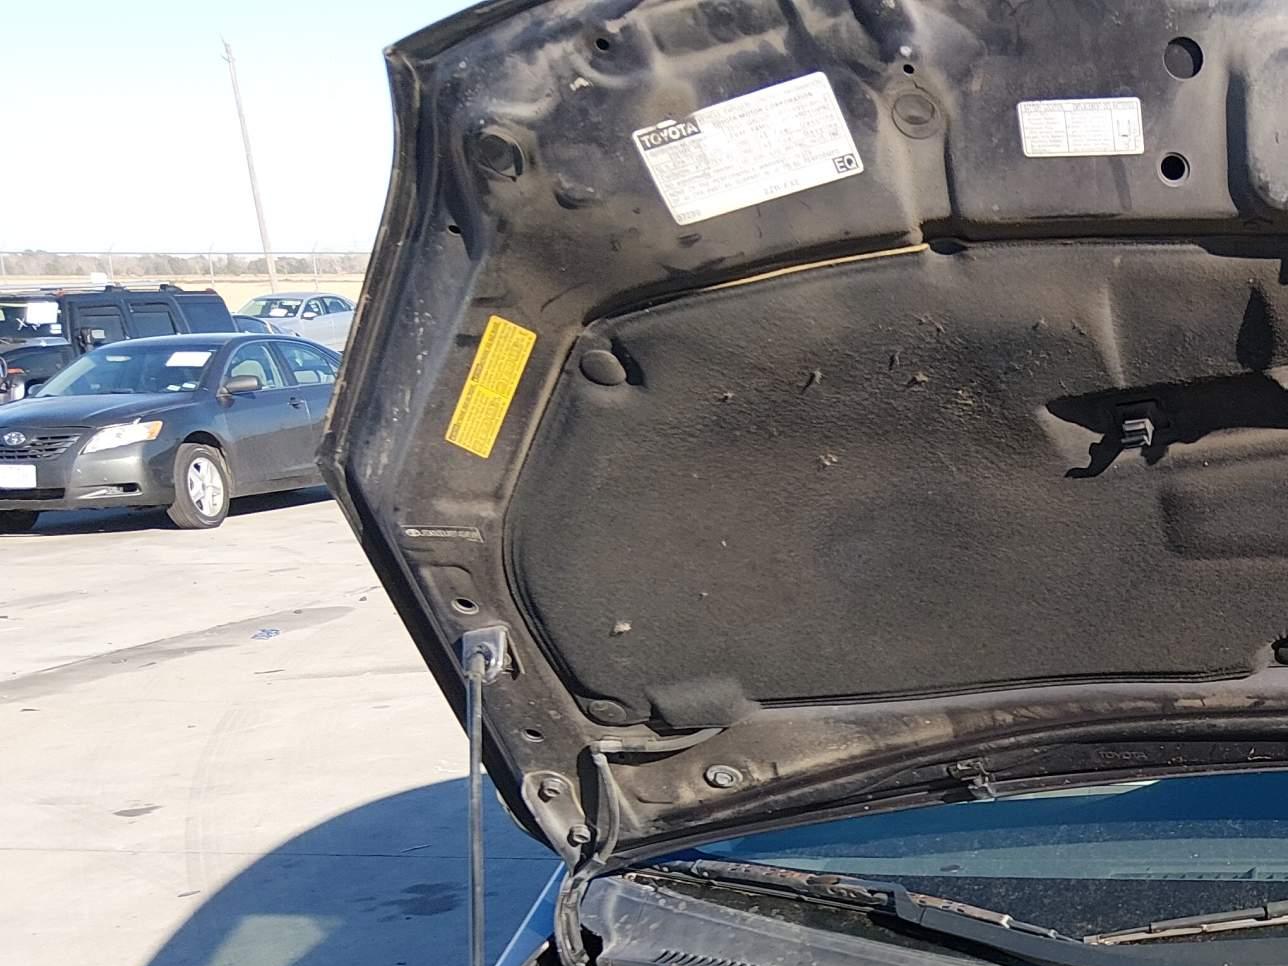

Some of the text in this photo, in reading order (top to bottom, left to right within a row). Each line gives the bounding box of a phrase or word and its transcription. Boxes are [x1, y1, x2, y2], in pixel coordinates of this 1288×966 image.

[640, 121, 698, 149] TOYOTA
[835, 154, 858, 173] EQ
[1099, 751, 1148, 761] TOYOTA
